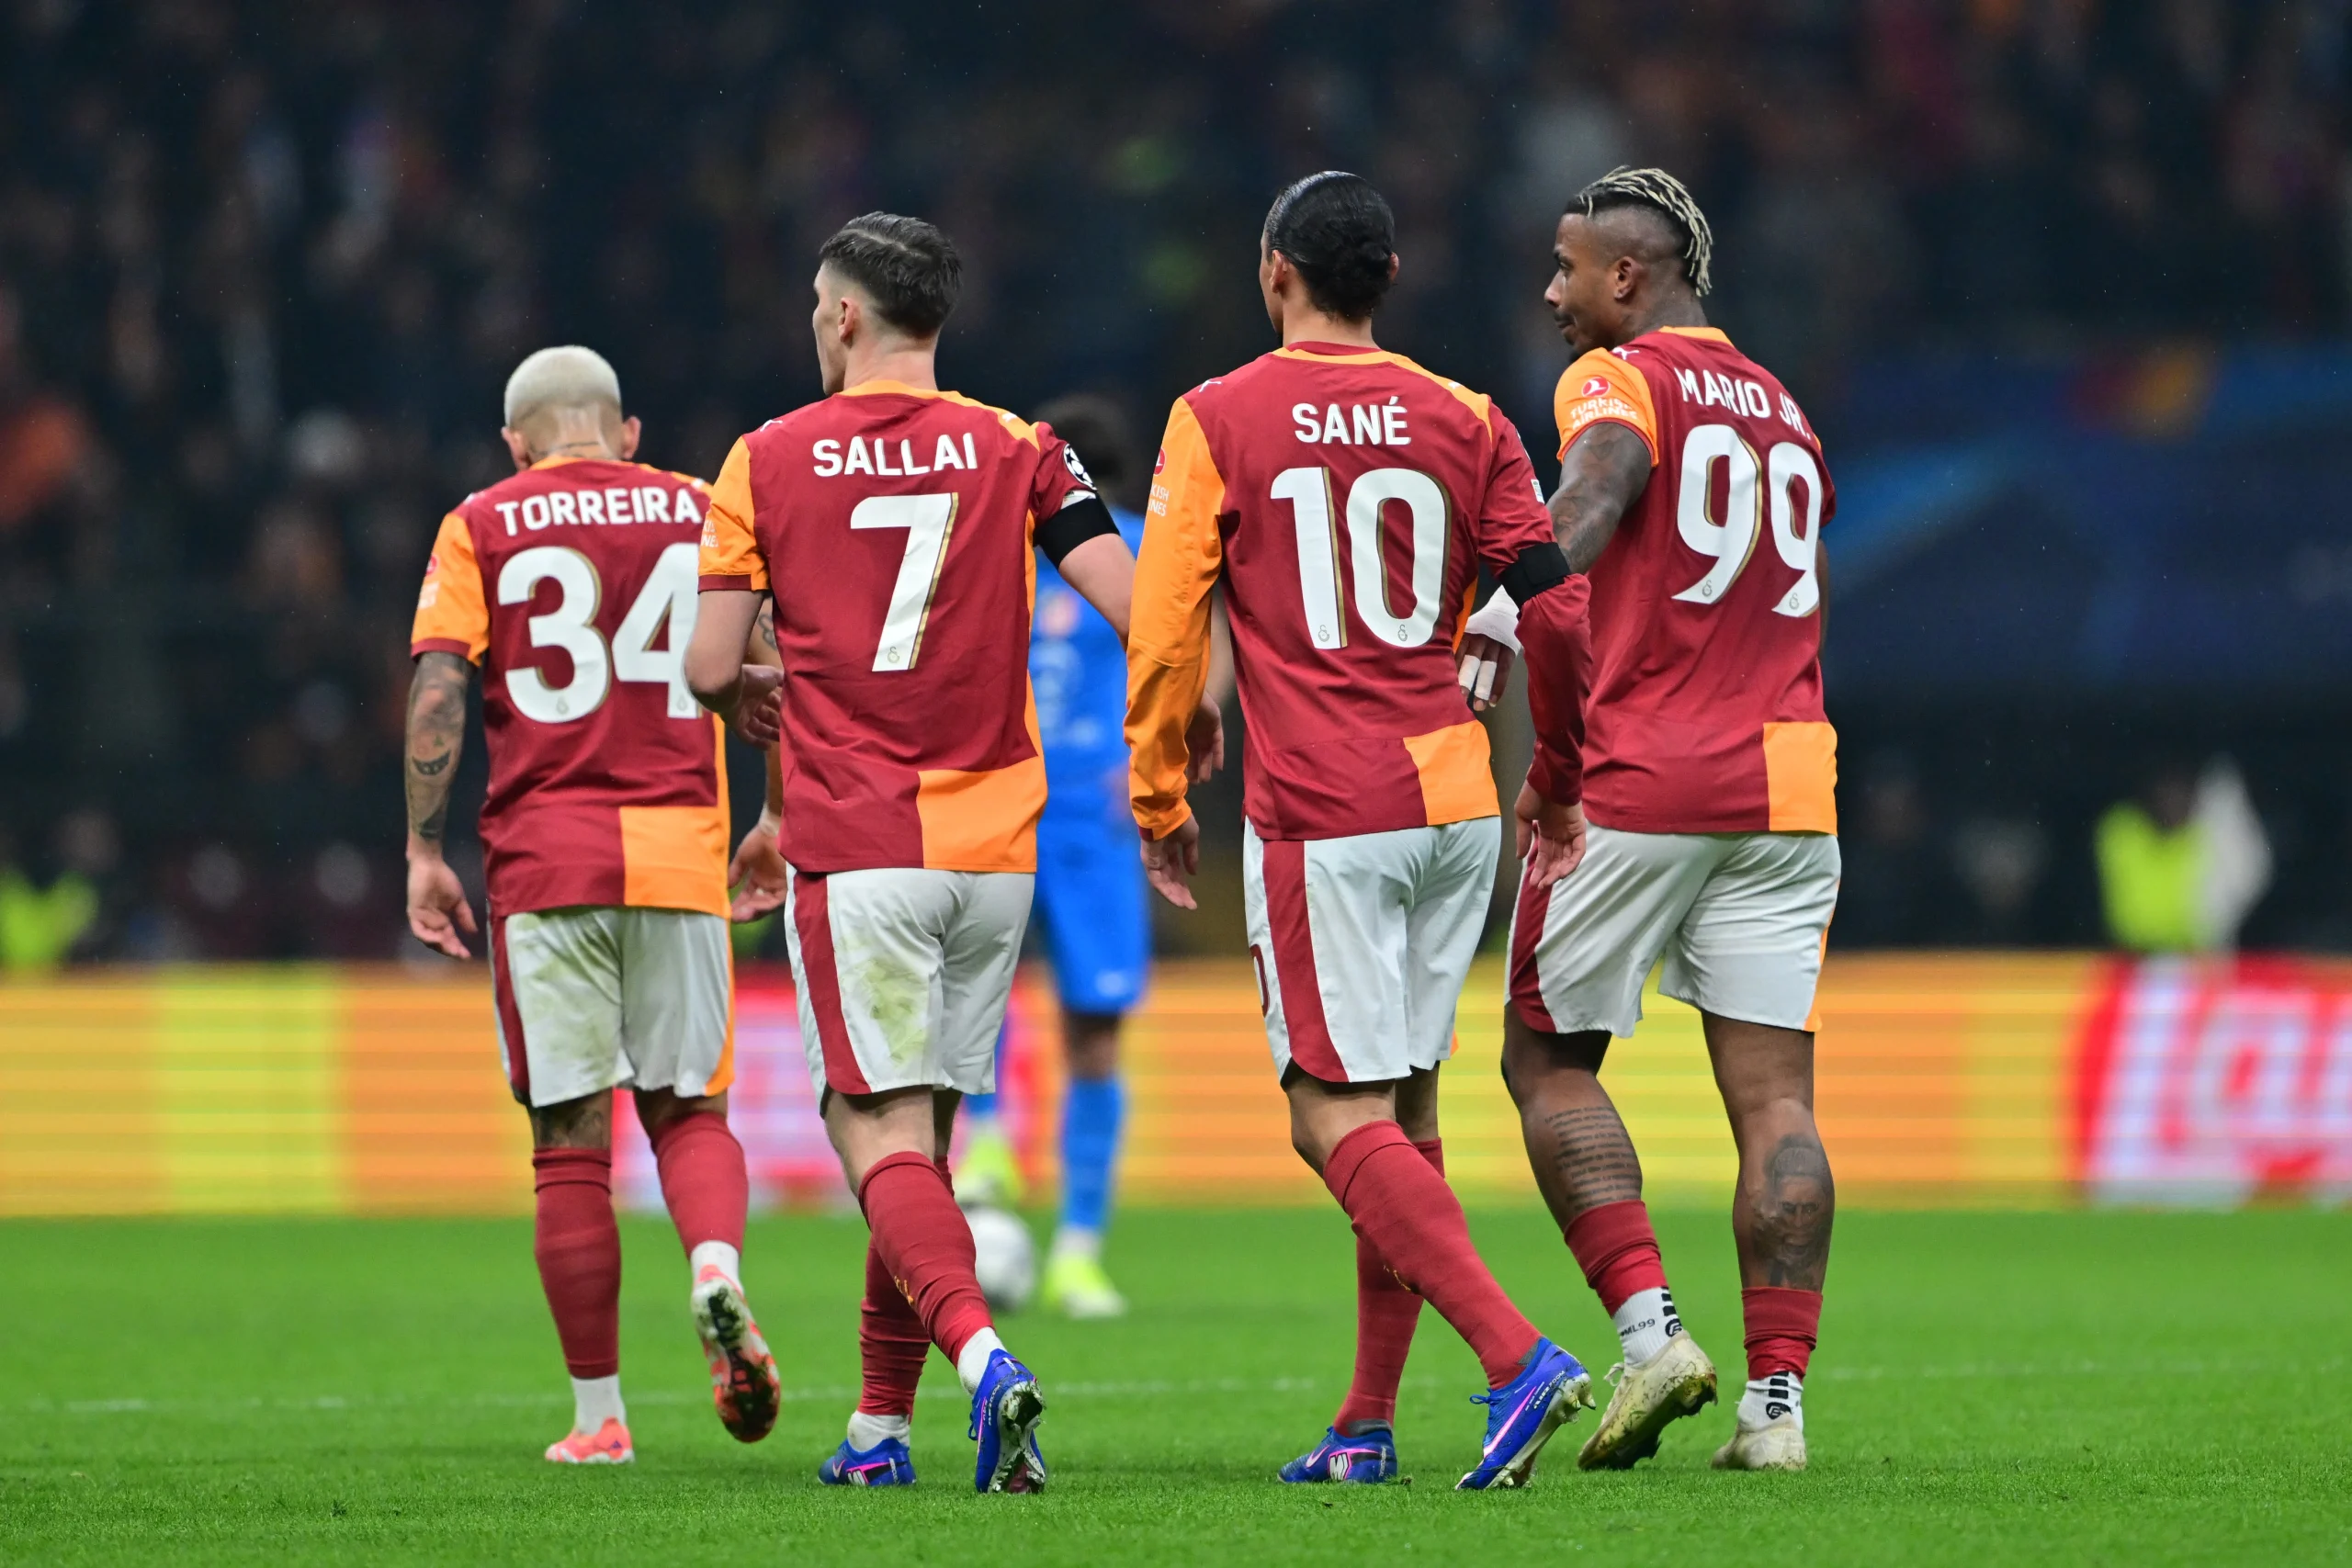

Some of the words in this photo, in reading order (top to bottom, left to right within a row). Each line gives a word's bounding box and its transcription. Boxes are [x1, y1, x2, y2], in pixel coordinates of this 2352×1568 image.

[1292, 395, 1411, 446] SANÉ
[1674, 367, 1771, 418] MARIO
[1779, 391, 1812, 440] JR.
[812, 433, 978, 477] SALLAI
[495, 487, 703, 536] TORREIRA
[1151, 485, 1169, 501] KISH
[1671, 424, 1822, 617] 99
[850, 492, 959, 672] 7
[1270, 467, 1451, 649] 10
[497, 542, 702, 724] 34
